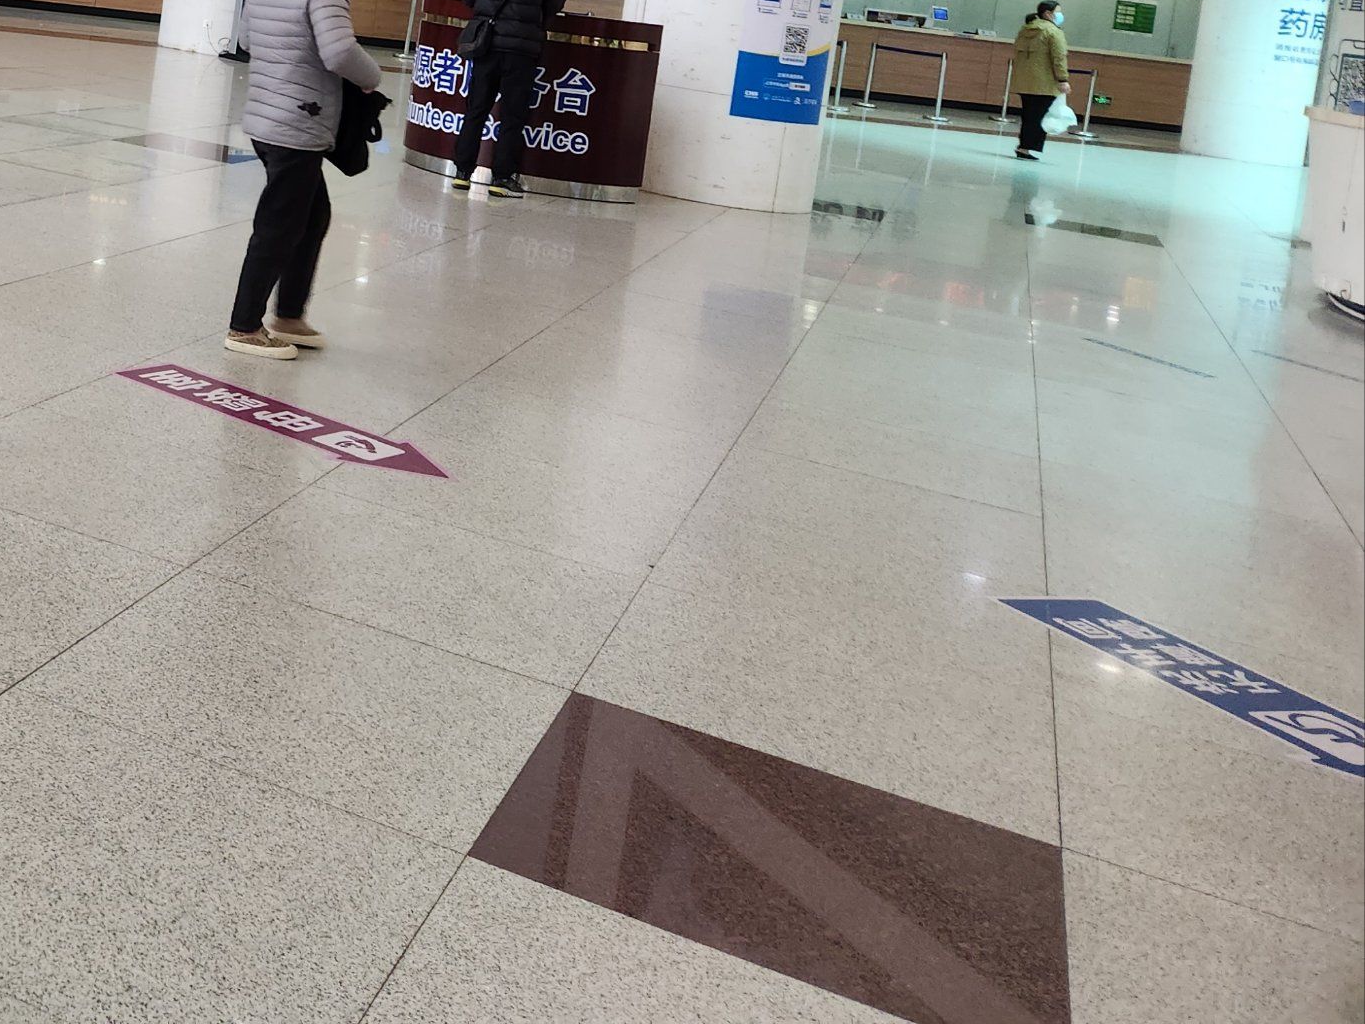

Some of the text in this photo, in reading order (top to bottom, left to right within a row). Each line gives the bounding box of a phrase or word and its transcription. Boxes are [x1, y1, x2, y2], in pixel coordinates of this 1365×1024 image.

[138, 368, 324, 433] 母婴室
[1052, 617, 1239, 696] 洗手间
